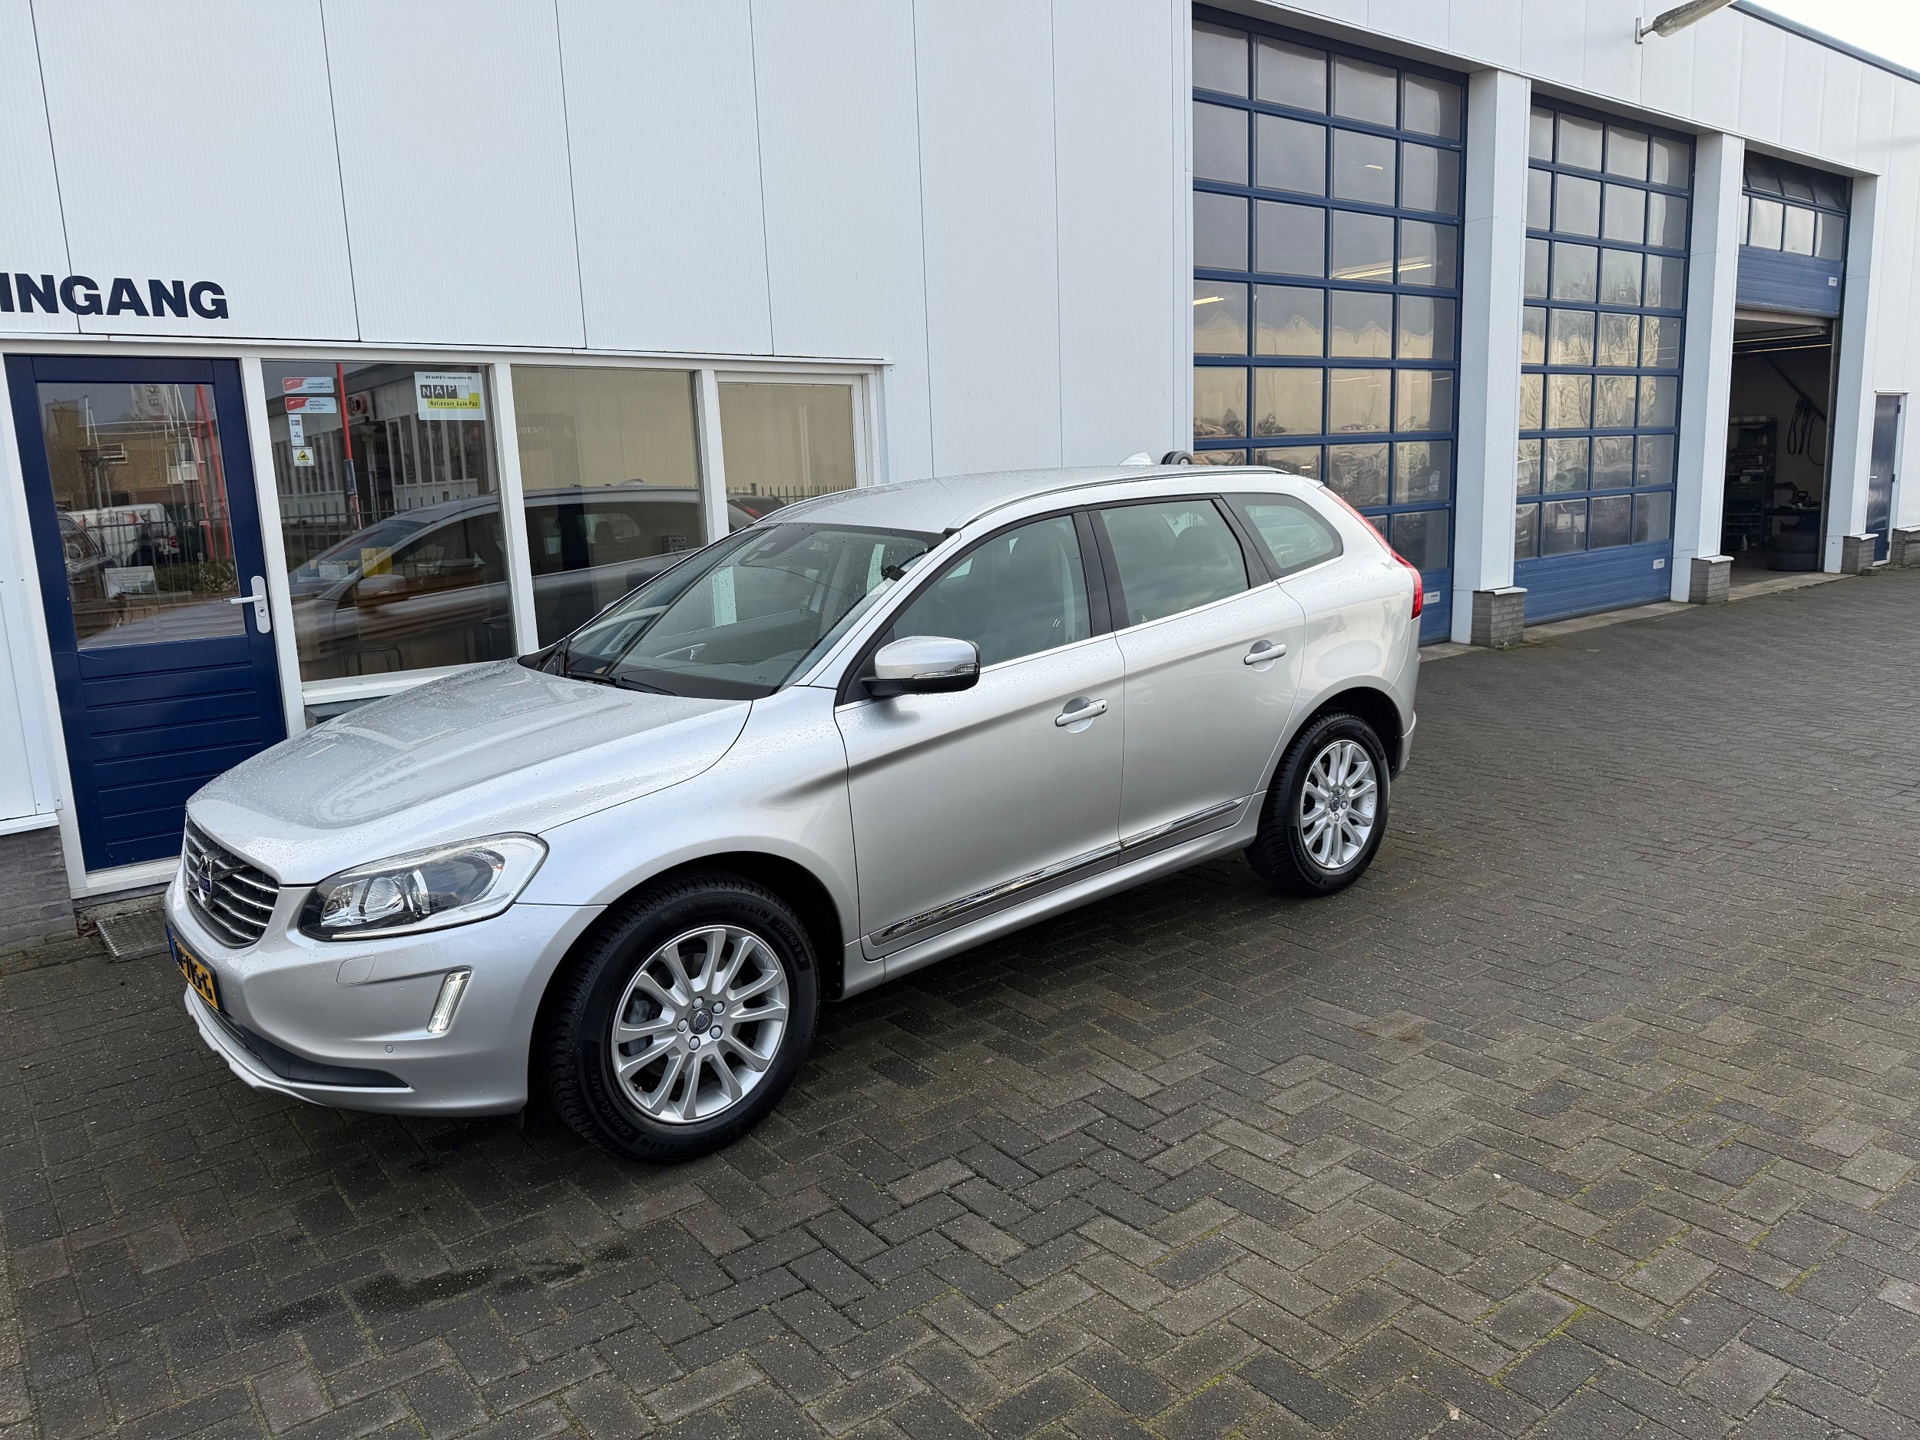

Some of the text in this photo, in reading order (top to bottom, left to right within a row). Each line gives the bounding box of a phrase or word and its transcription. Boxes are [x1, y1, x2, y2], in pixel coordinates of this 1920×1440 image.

[0, 272, 229, 319] INGANG
[422, 385, 455, 396] NAP
[776, 922, 798, 945] 235/60
